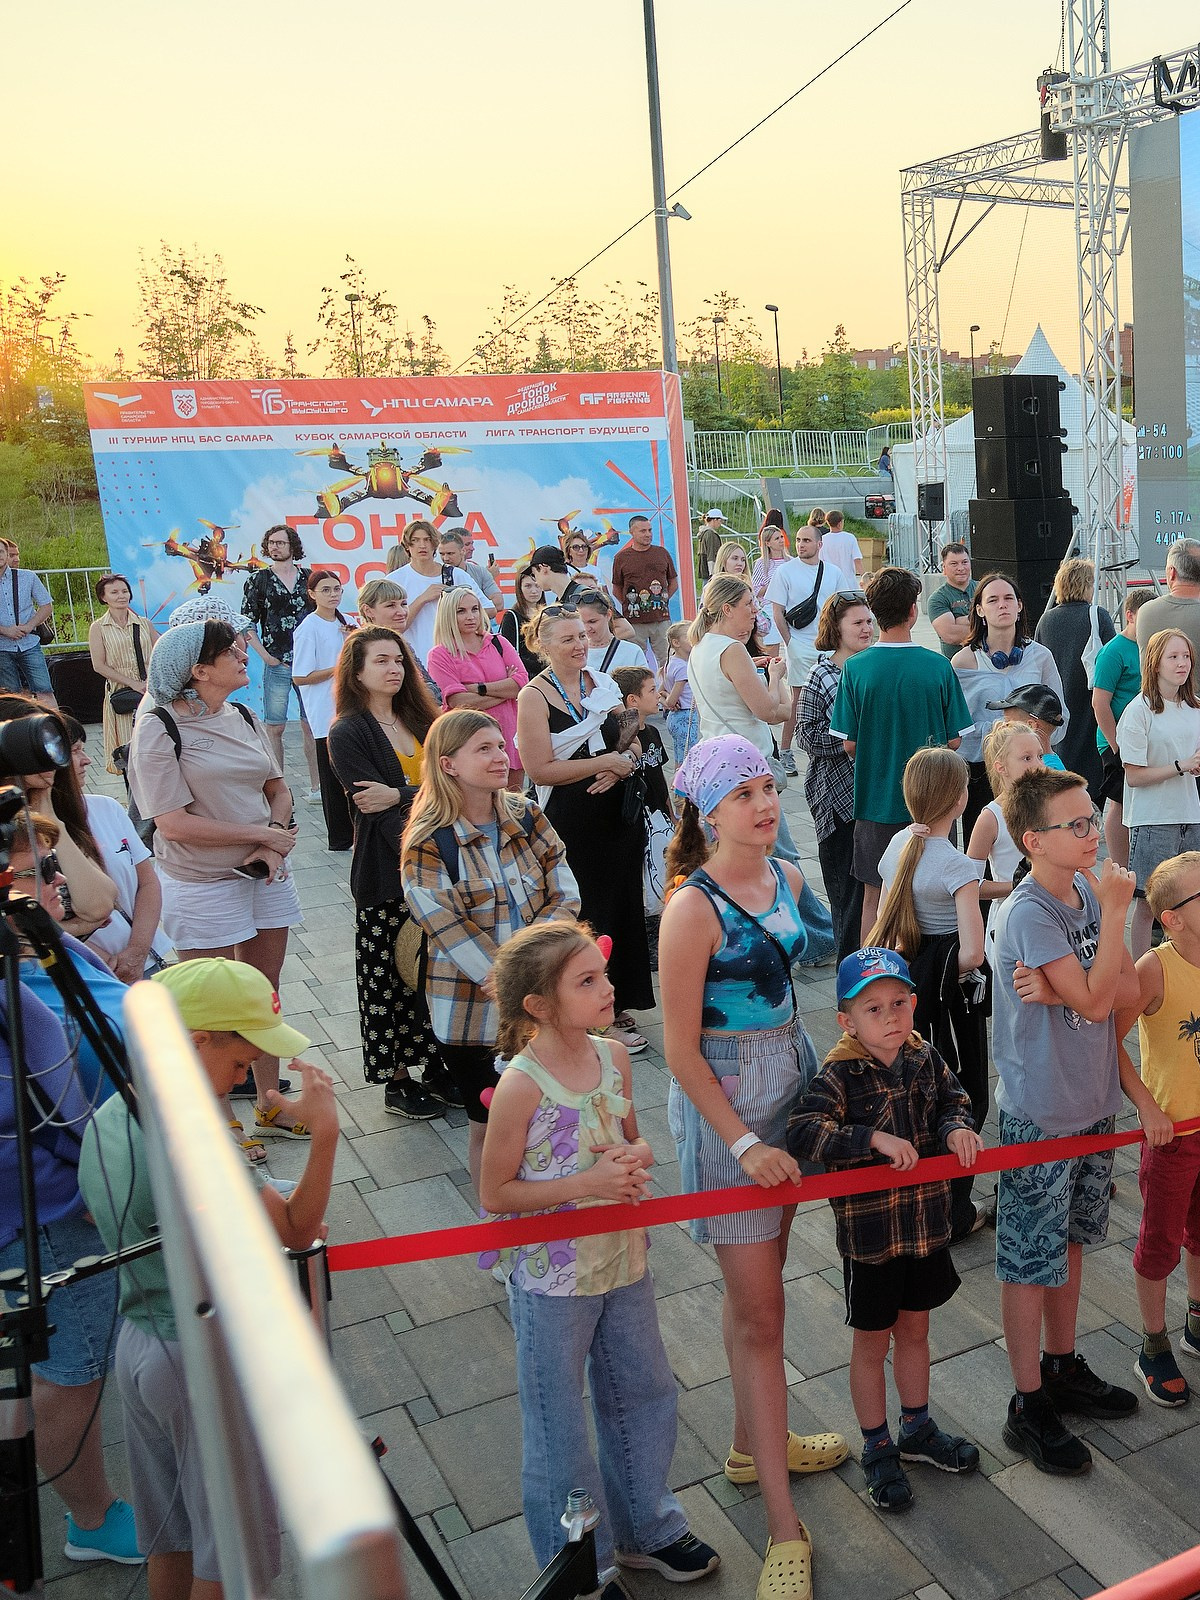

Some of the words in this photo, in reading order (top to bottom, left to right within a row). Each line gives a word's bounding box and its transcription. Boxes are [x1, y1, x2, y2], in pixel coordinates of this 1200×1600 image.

[522, 382, 557, 400] ГОНОК
[383, 397, 420, 408] НПЦ
[422, 396, 494, 408] САМАРА
[507, 394, 550, 416] ДРОНОВ
[295, 433, 335, 441] КУБОК
[339, 430, 411, 440] САМАРСКОЙ
[415, 430, 467, 439] ОБЛАСТИ
[485, 429, 515, 437] ЛИГА
[519, 427, 585, 436] ТРАНСПОРТ
[589, 426, 650, 435] БУДУЩЕГО
[122, 436, 168, 444] ТУРНИР
[171, 436, 196, 444] НПЦ
[199, 435, 222, 443] БАС
[225, 434, 274, 442] САМАРА
[857, 948, 885, 960] SURF
